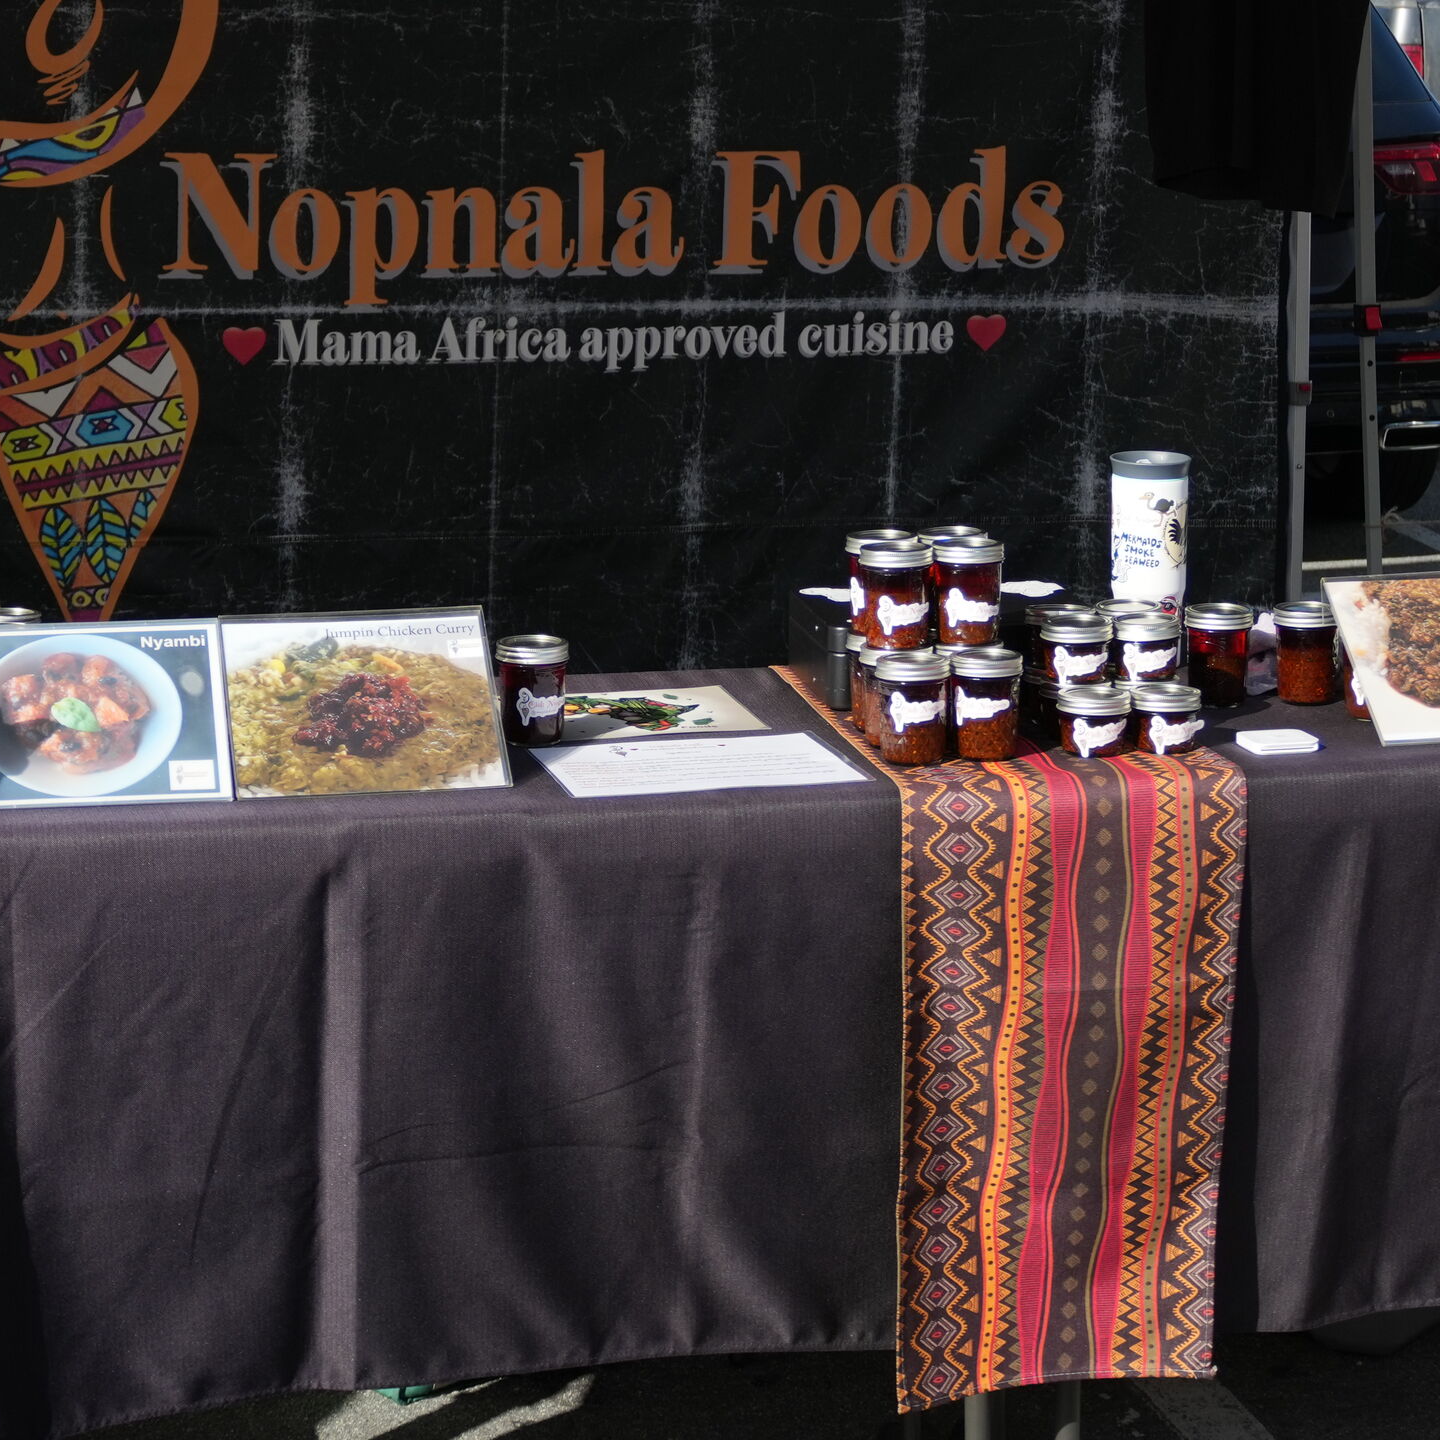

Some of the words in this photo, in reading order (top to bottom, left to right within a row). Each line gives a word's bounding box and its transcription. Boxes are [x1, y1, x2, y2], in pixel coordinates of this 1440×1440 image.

[160, 150, 686, 306] Nopnala
[709, 146, 1067, 277] Foods
[271, 317, 421, 368] Mama
[427, 315, 572, 366] Africa
[575, 312, 786, 371] approved
[797, 310, 956, 360] cuisine
[1120, 531, 1163, 548] MERMAIDS
[1124, 544, 1155, 558] SMOKE
[1124, 555, 1160, 568] SEAWEED
[325, 626, 373, 641] Jumpin
[377, 624, 433, 639] Chicken
[435, 622, 475, 638] Curry
[140, 635, 206, 652] Nyambi
